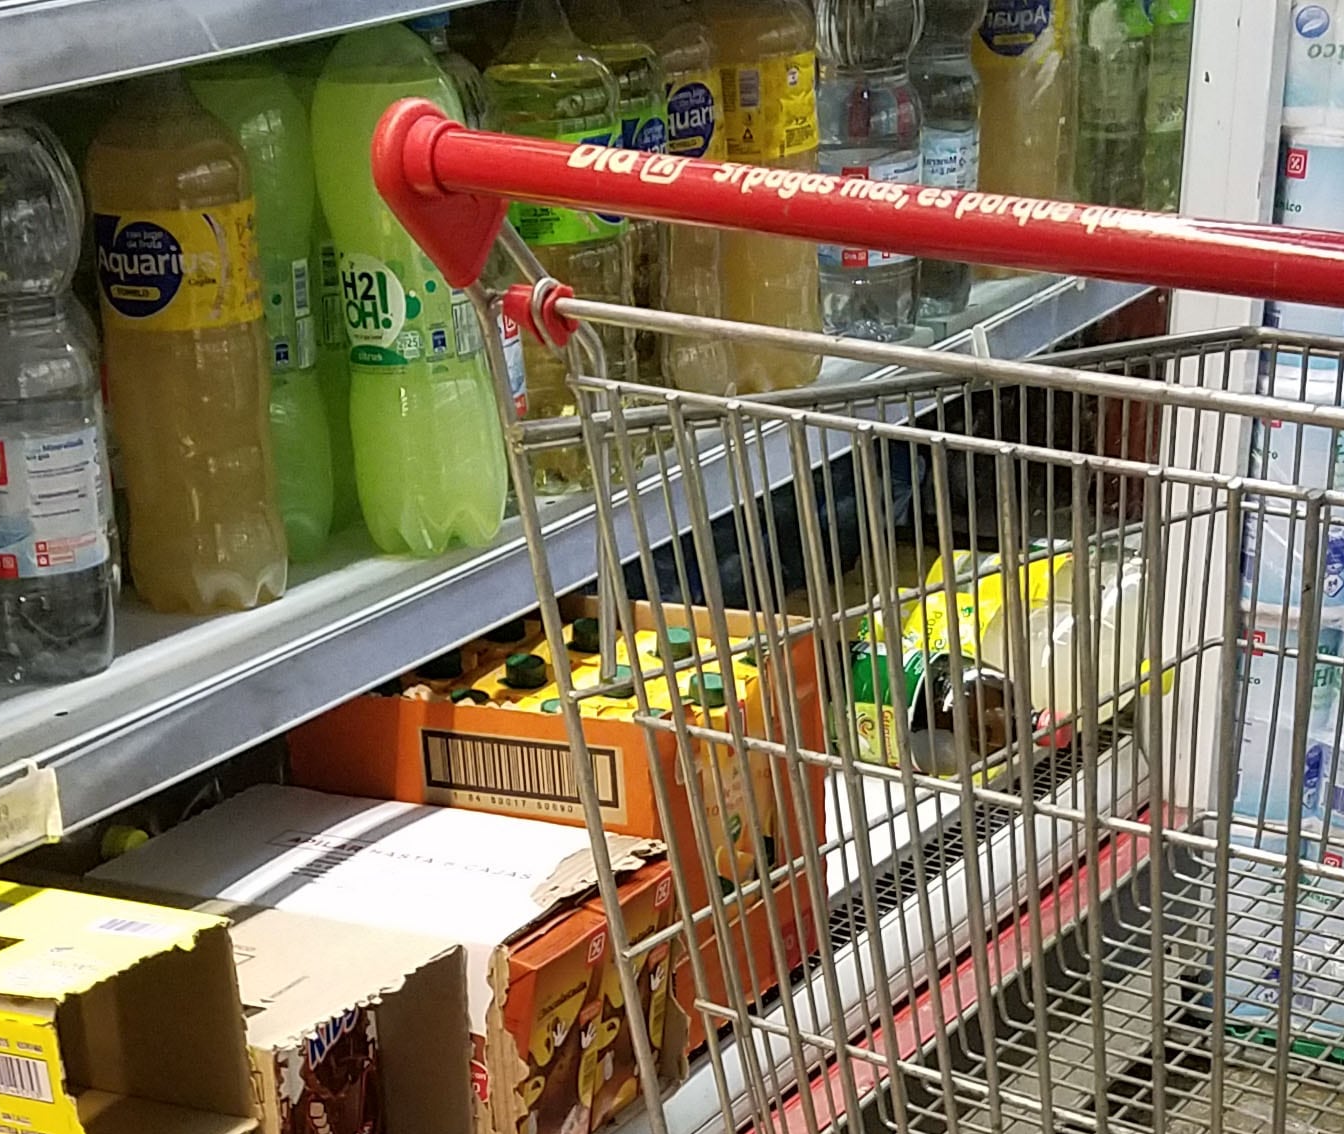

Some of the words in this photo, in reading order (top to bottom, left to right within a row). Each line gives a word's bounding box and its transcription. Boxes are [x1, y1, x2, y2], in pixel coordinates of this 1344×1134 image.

[917, 184, 956, 209] es
[956, 191, 1074, 226] porque
[98, 245, 218, 281] Aquarius
[463, 862, 534, 882] CAJAS
